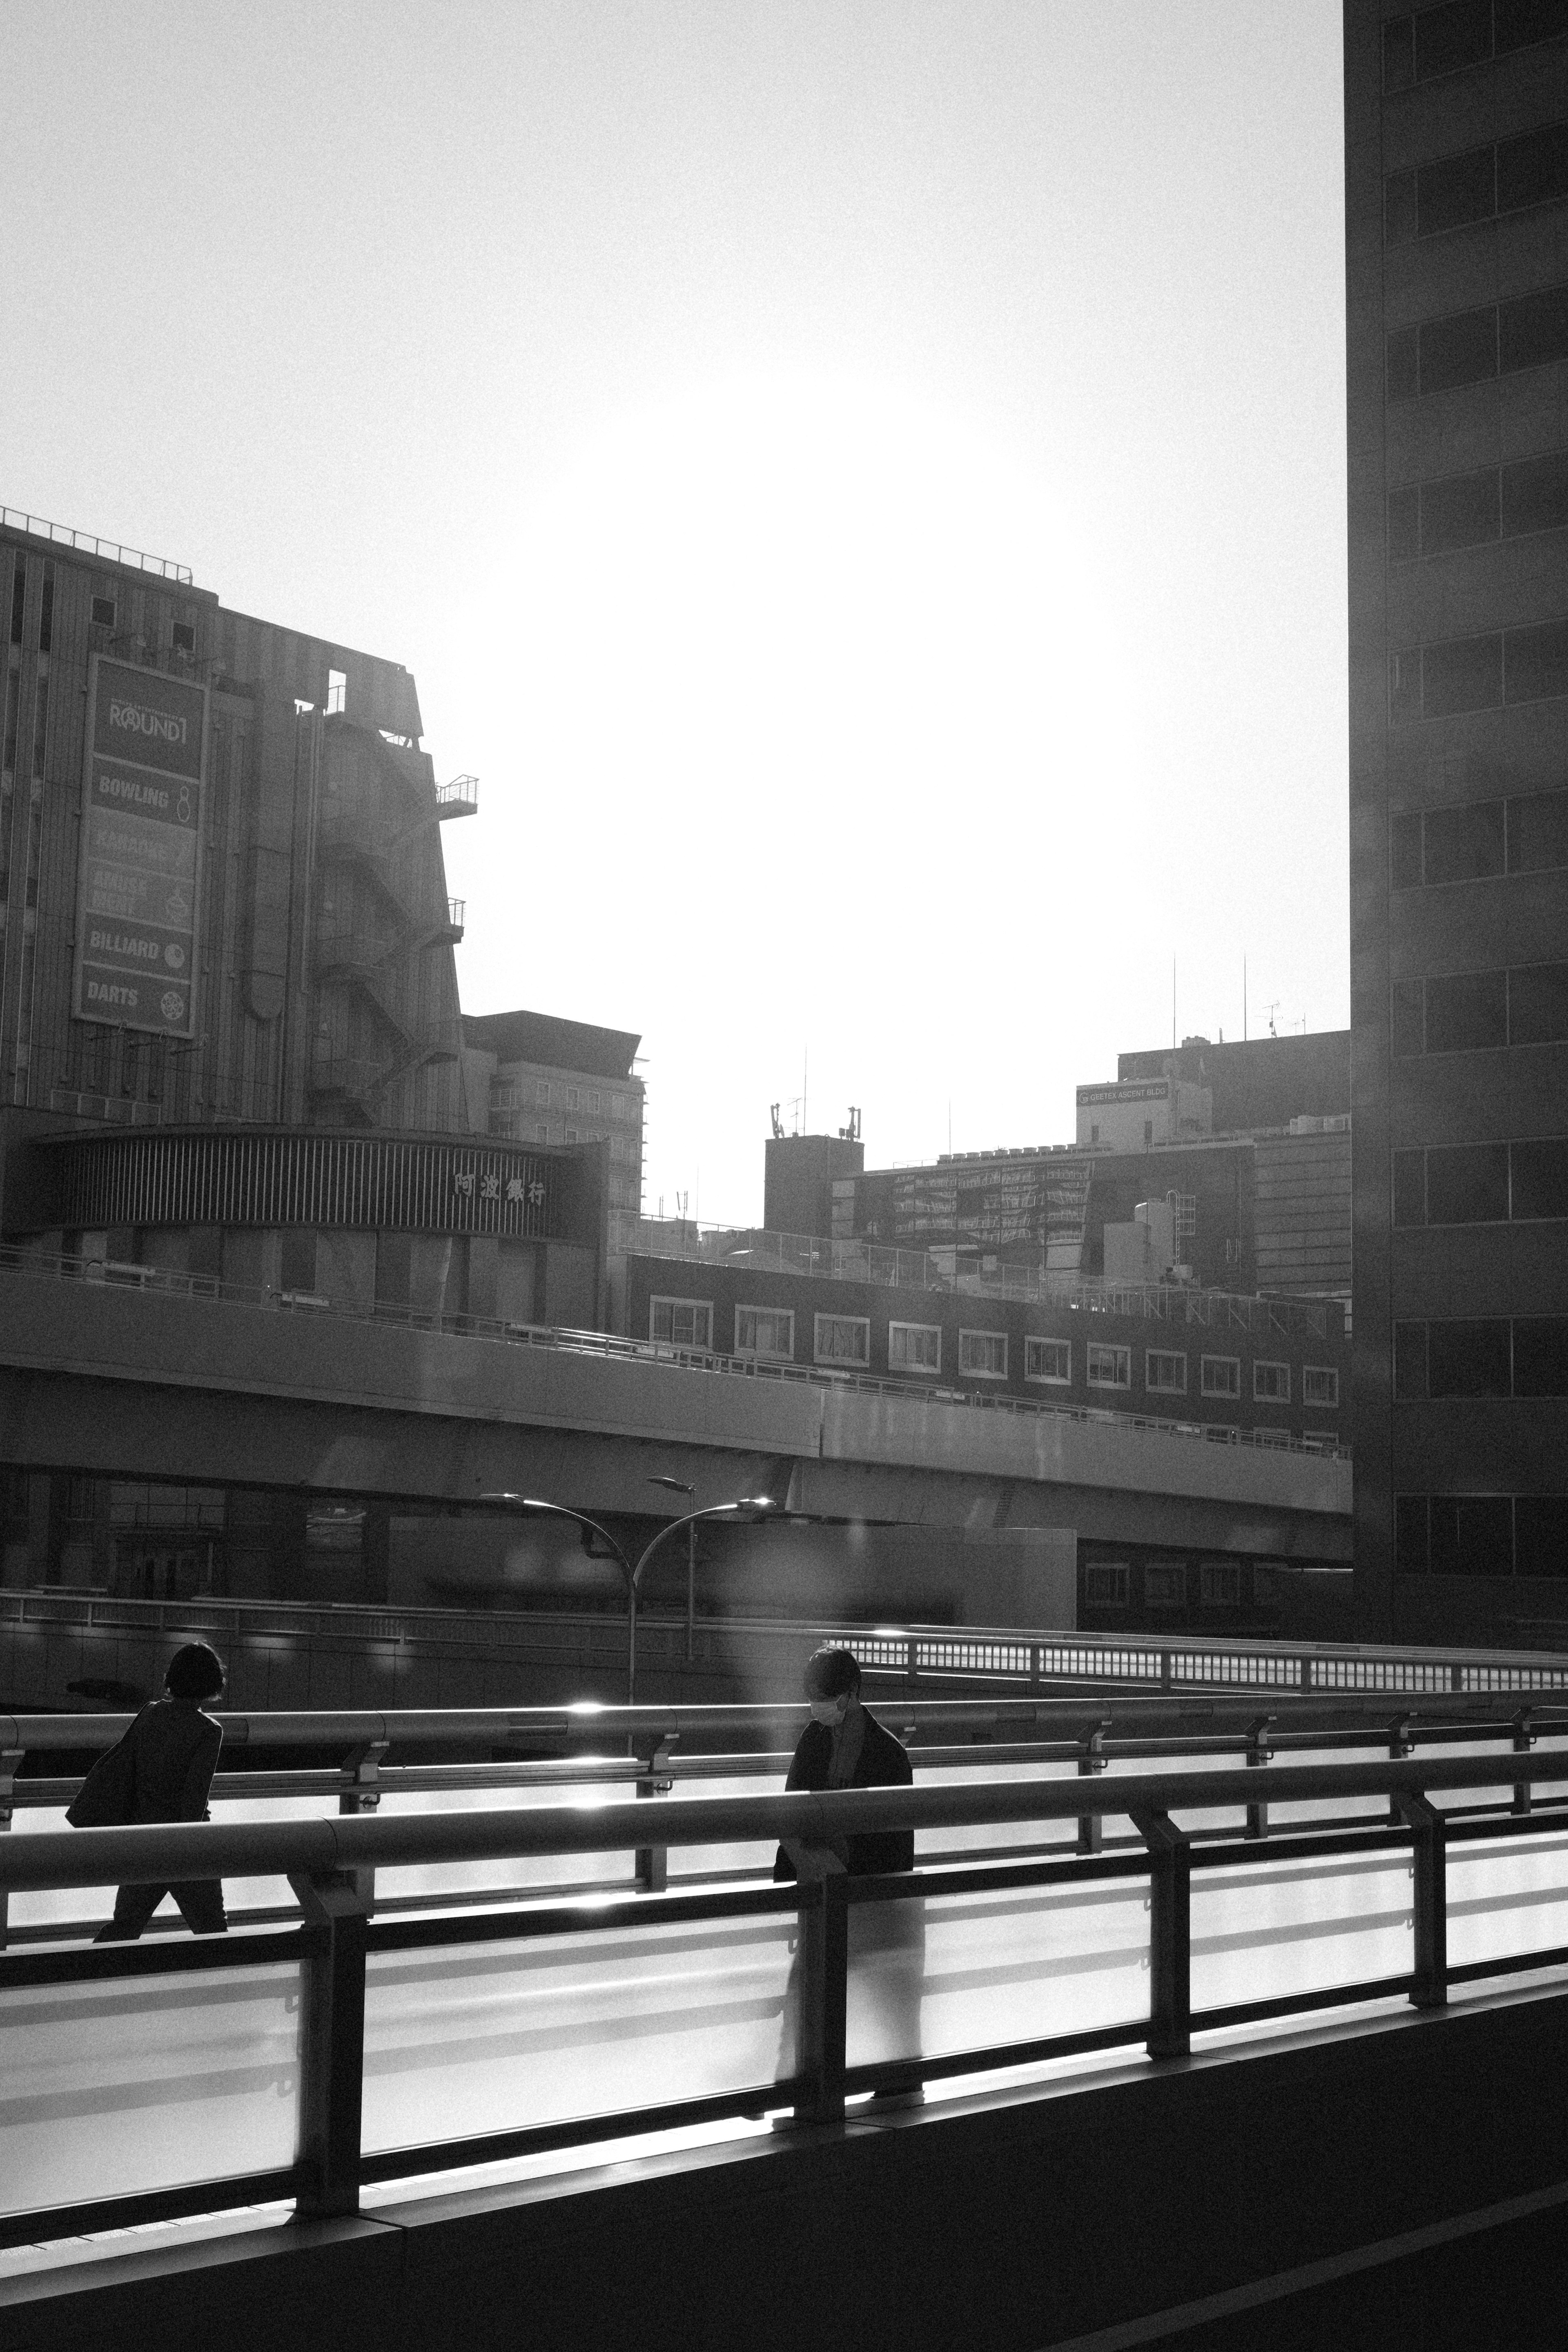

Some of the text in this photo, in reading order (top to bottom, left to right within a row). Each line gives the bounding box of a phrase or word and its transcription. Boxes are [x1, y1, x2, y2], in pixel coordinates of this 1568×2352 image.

[99, 775, 169, 808] BOWLING
[90, 930, 159, 960] BILLIARD
[87, 981, 138, 1007] DARTS
[1090, 1092, 1117, 1100] GEETEX
[1118, 1089, 1145, 1098] ASCENT
[454, 1172, 546, 1206] 阿波銀行
